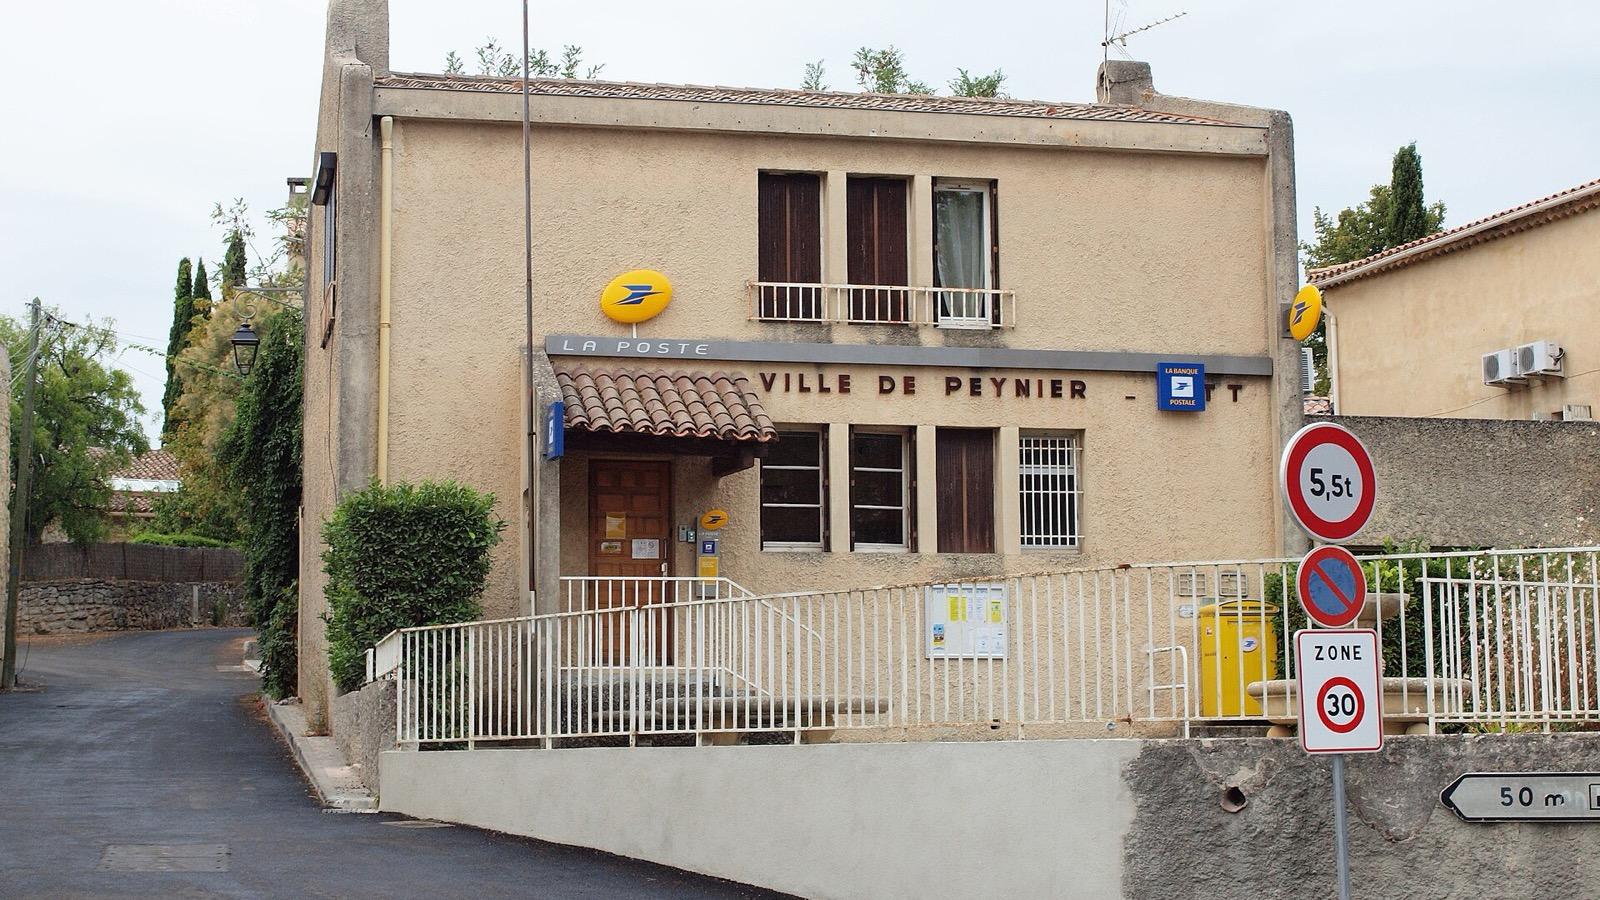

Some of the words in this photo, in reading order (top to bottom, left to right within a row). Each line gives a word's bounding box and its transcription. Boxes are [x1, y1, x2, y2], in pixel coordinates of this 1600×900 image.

[563, 340, 597, 352] LA
[616, 341, 709, 355] POSTE
[759, 372, 851, 394] VILLE
[878, 375, 916, 395] DE
[945, 376, 1087, 399] PEYNIER
[1204, 383, 1243, 402] TT
[1310, 468, 1353, 501] 5,5t
[1314, 645, 1362, 661] ZONE
[1327, 693, 1356, 716] 30
[1500, 786, 1534, 807] 50
